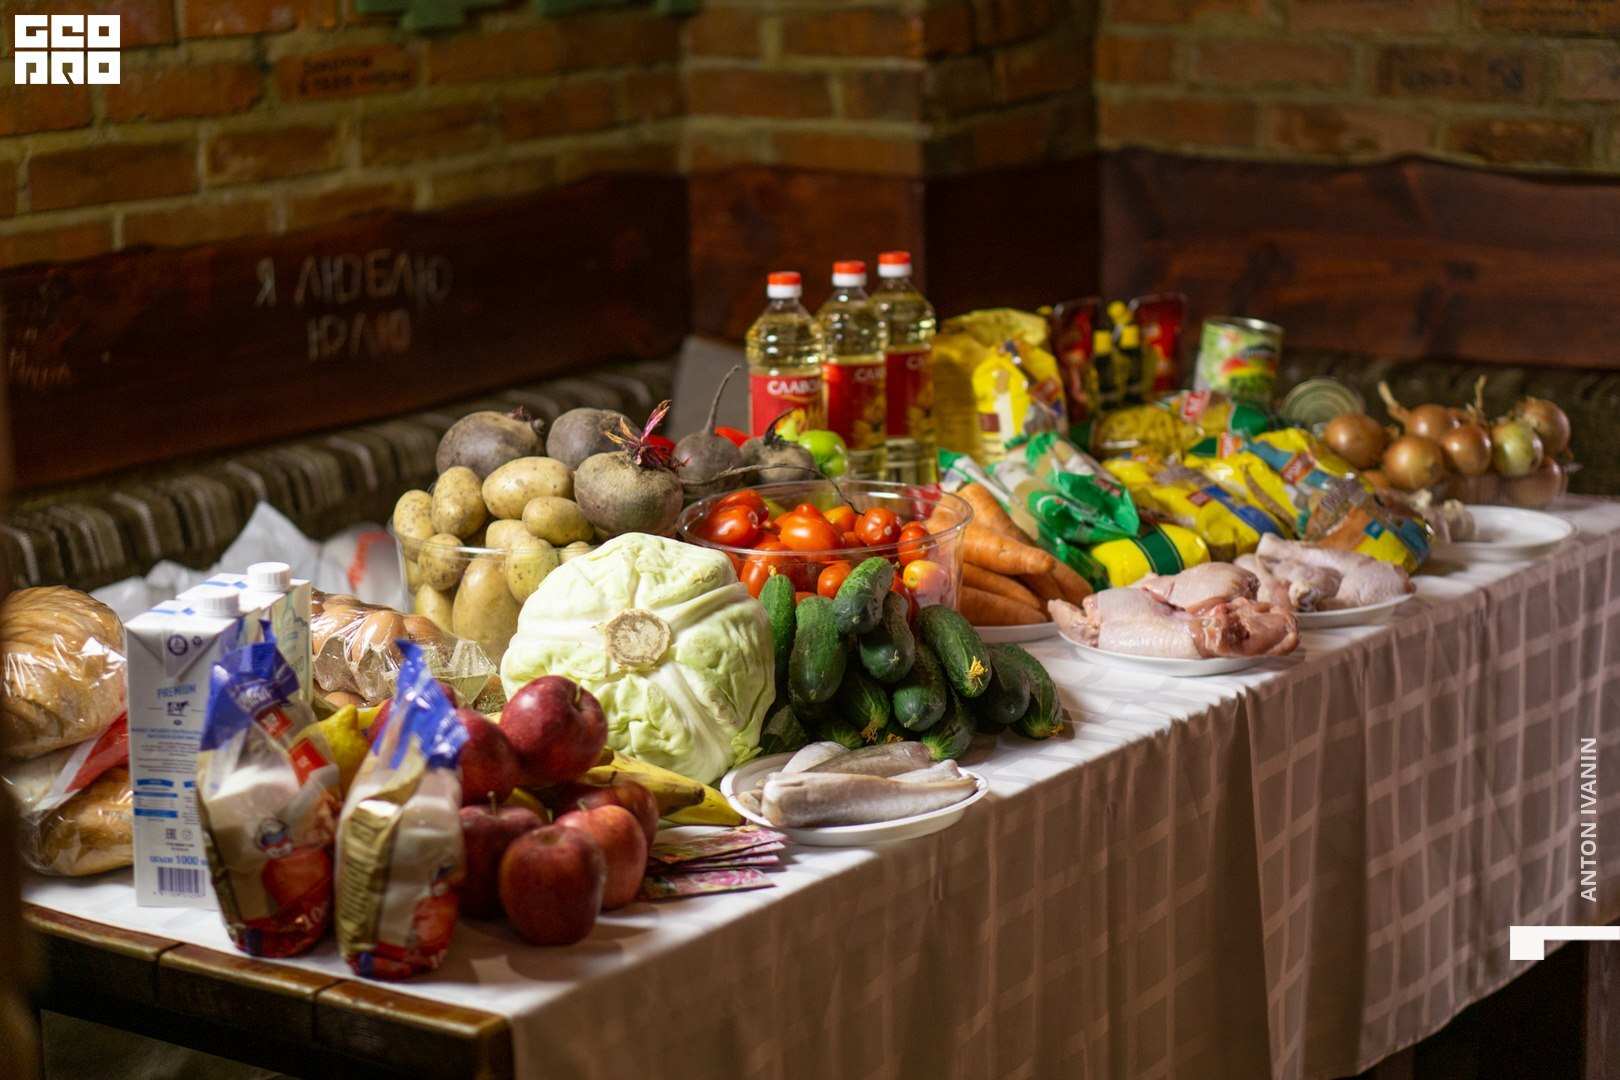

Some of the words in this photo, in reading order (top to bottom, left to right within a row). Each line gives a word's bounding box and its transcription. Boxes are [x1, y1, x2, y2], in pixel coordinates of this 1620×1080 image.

[254, 256, 277, 309] Я
[294, 249, 453, 308] ЛЮБЛЮ
[156, 684, 196, 699] PREMIUM
[176, 855, 199, 866] 1000
